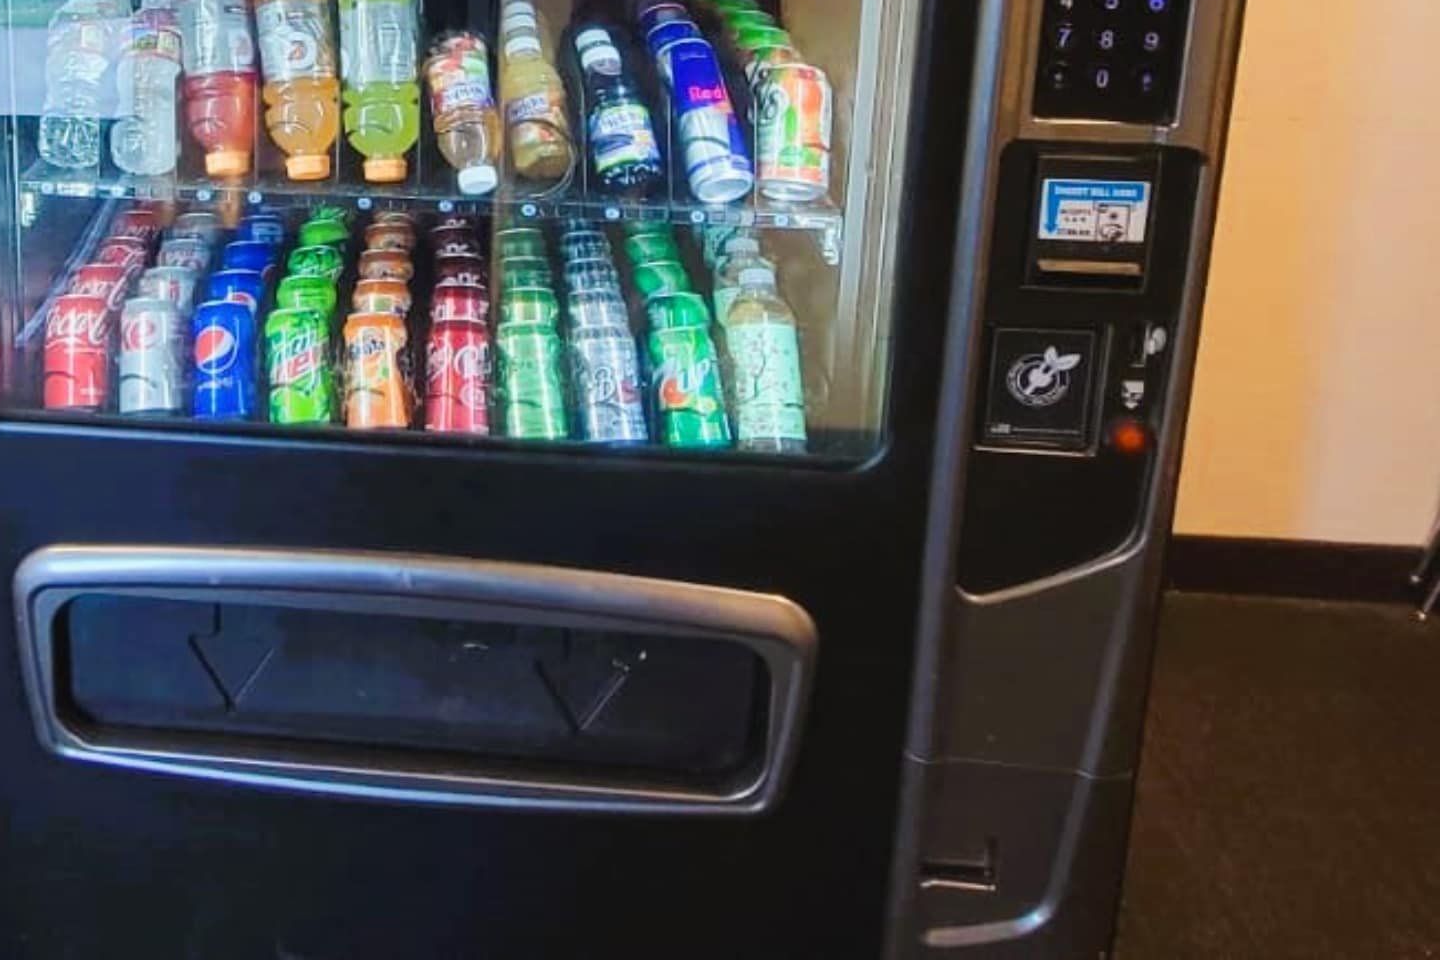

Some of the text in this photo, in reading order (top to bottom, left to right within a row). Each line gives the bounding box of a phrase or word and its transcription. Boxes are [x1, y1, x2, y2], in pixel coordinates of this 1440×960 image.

[1060, 28, 1072, 48] 7
[1099, 29, 1114, 50] 8
[1143, 31, 1160, 51] 9
[1095, 69, 1109, 88] 0
[688, 85, 725, 101] Red
